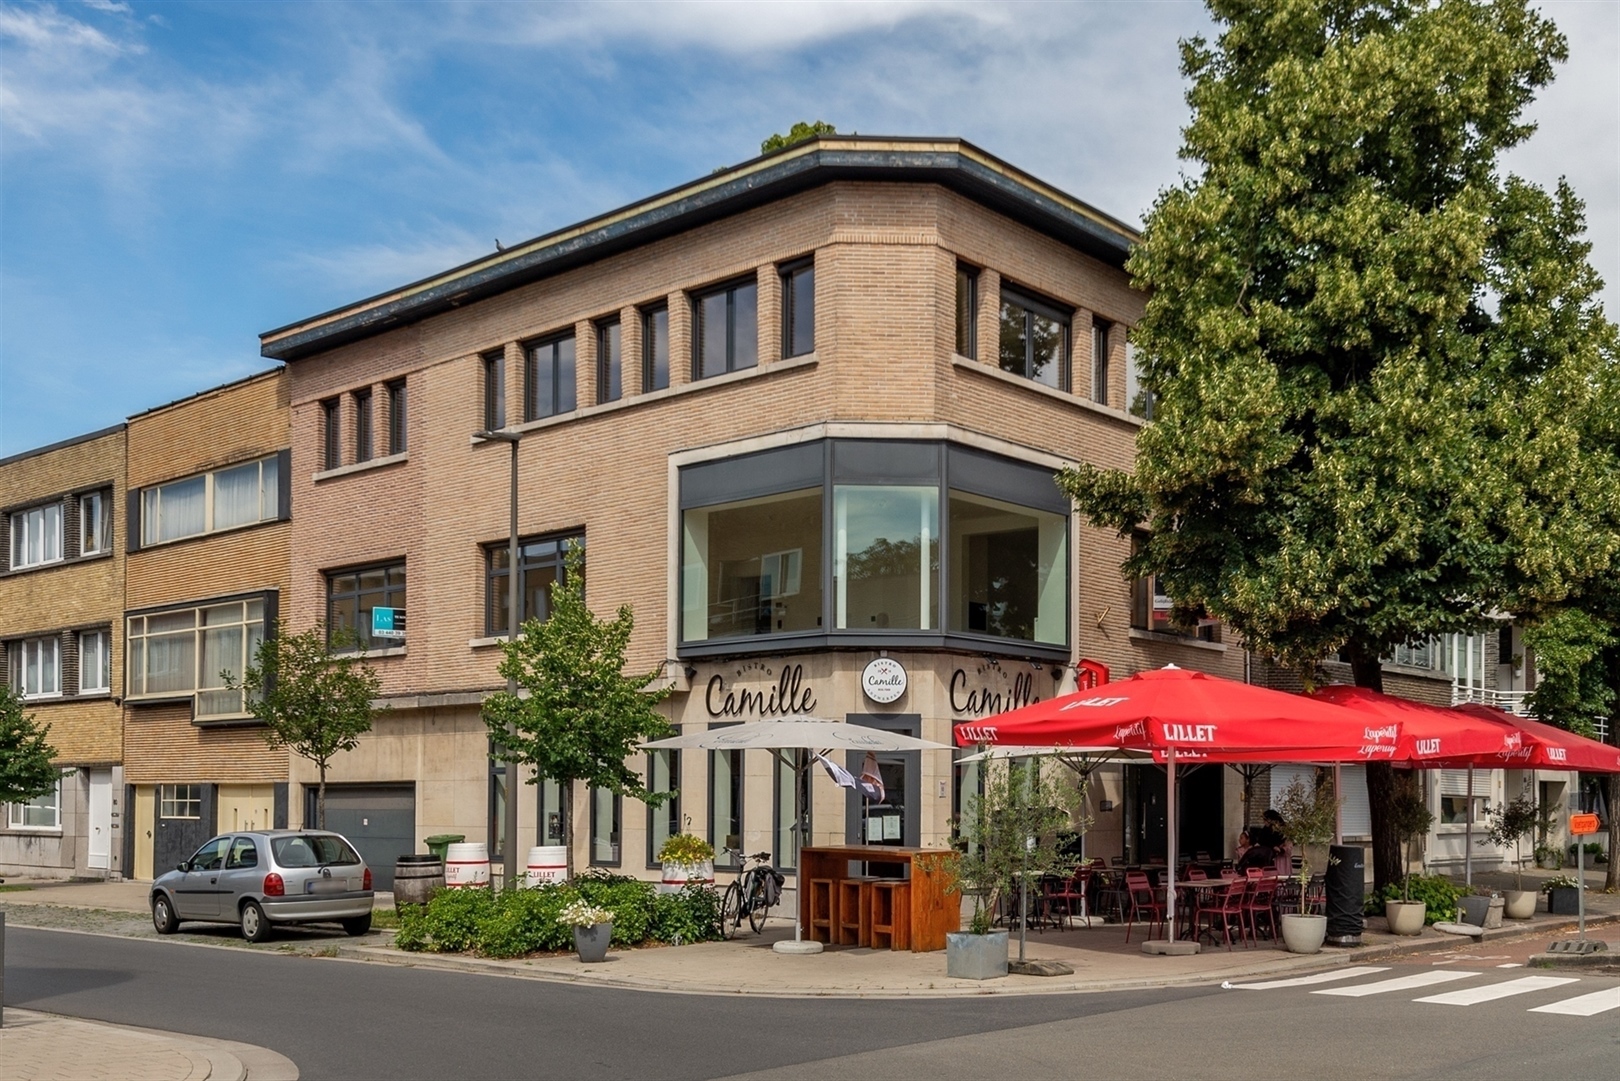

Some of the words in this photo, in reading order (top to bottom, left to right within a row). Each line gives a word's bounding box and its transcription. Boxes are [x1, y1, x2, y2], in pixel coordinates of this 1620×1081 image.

[736, 662, 772, 677] BISTRO
[977, 663, 1007, 678] BISTRO
[868, 675, 903, 686] Camille
[705, 664, 817, 716] Camille
[960, 726, 998, 740] LILLET
[1163, 723, 1217, 742] LILLET
